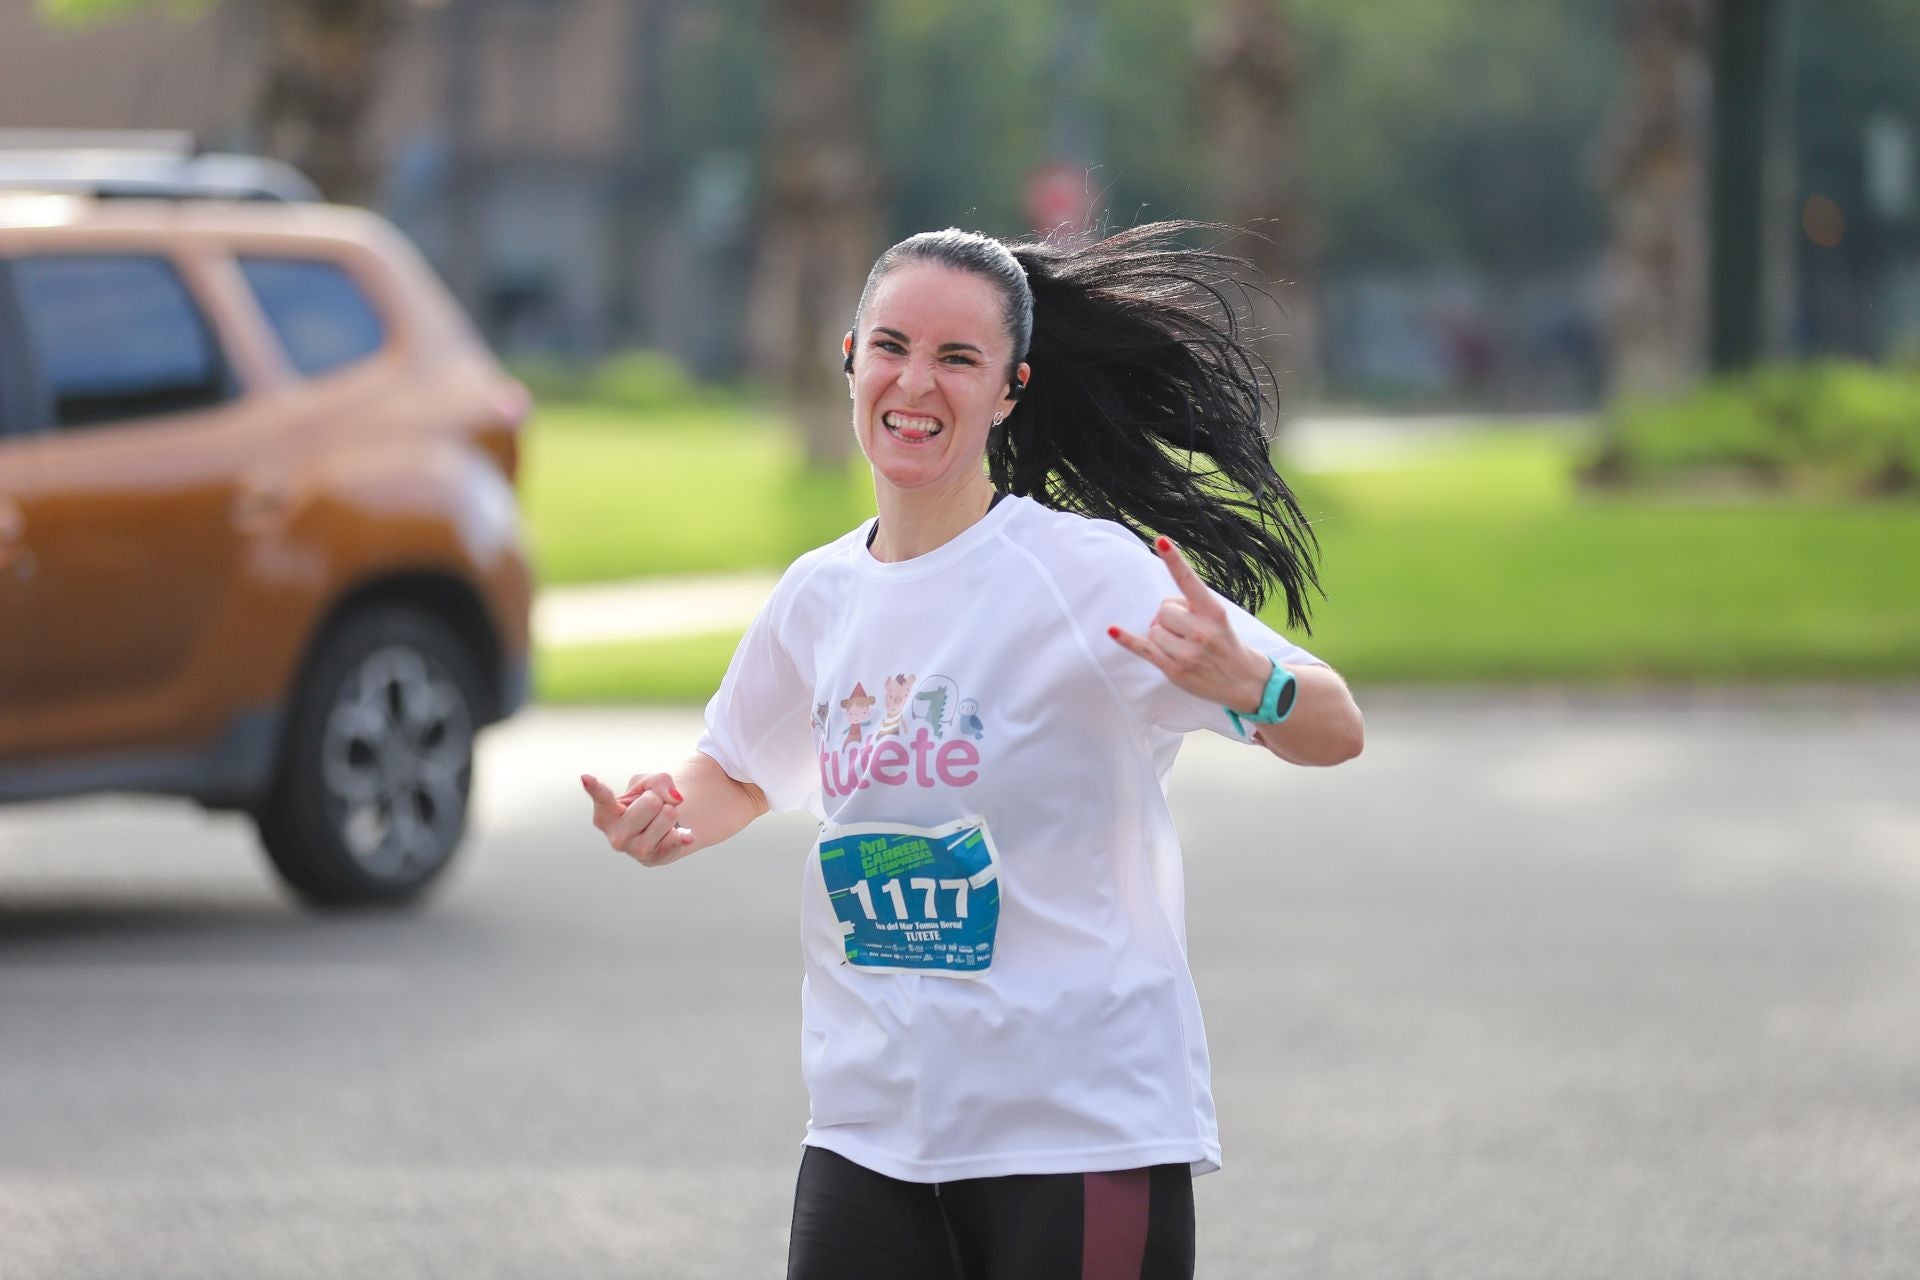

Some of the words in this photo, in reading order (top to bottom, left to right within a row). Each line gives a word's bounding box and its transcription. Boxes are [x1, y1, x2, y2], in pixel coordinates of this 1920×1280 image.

[820, 727, 980, 798] tutete
[862, 839, 929, 870] CARRERA
[880, 850, 933, 873] EMPRESAS
[850, 878, 969, 920] 1177
[887, 922, 899, 931] del
[899, 921, 914, 930] Mar
[904, 931, 941, 942] TUTETE
